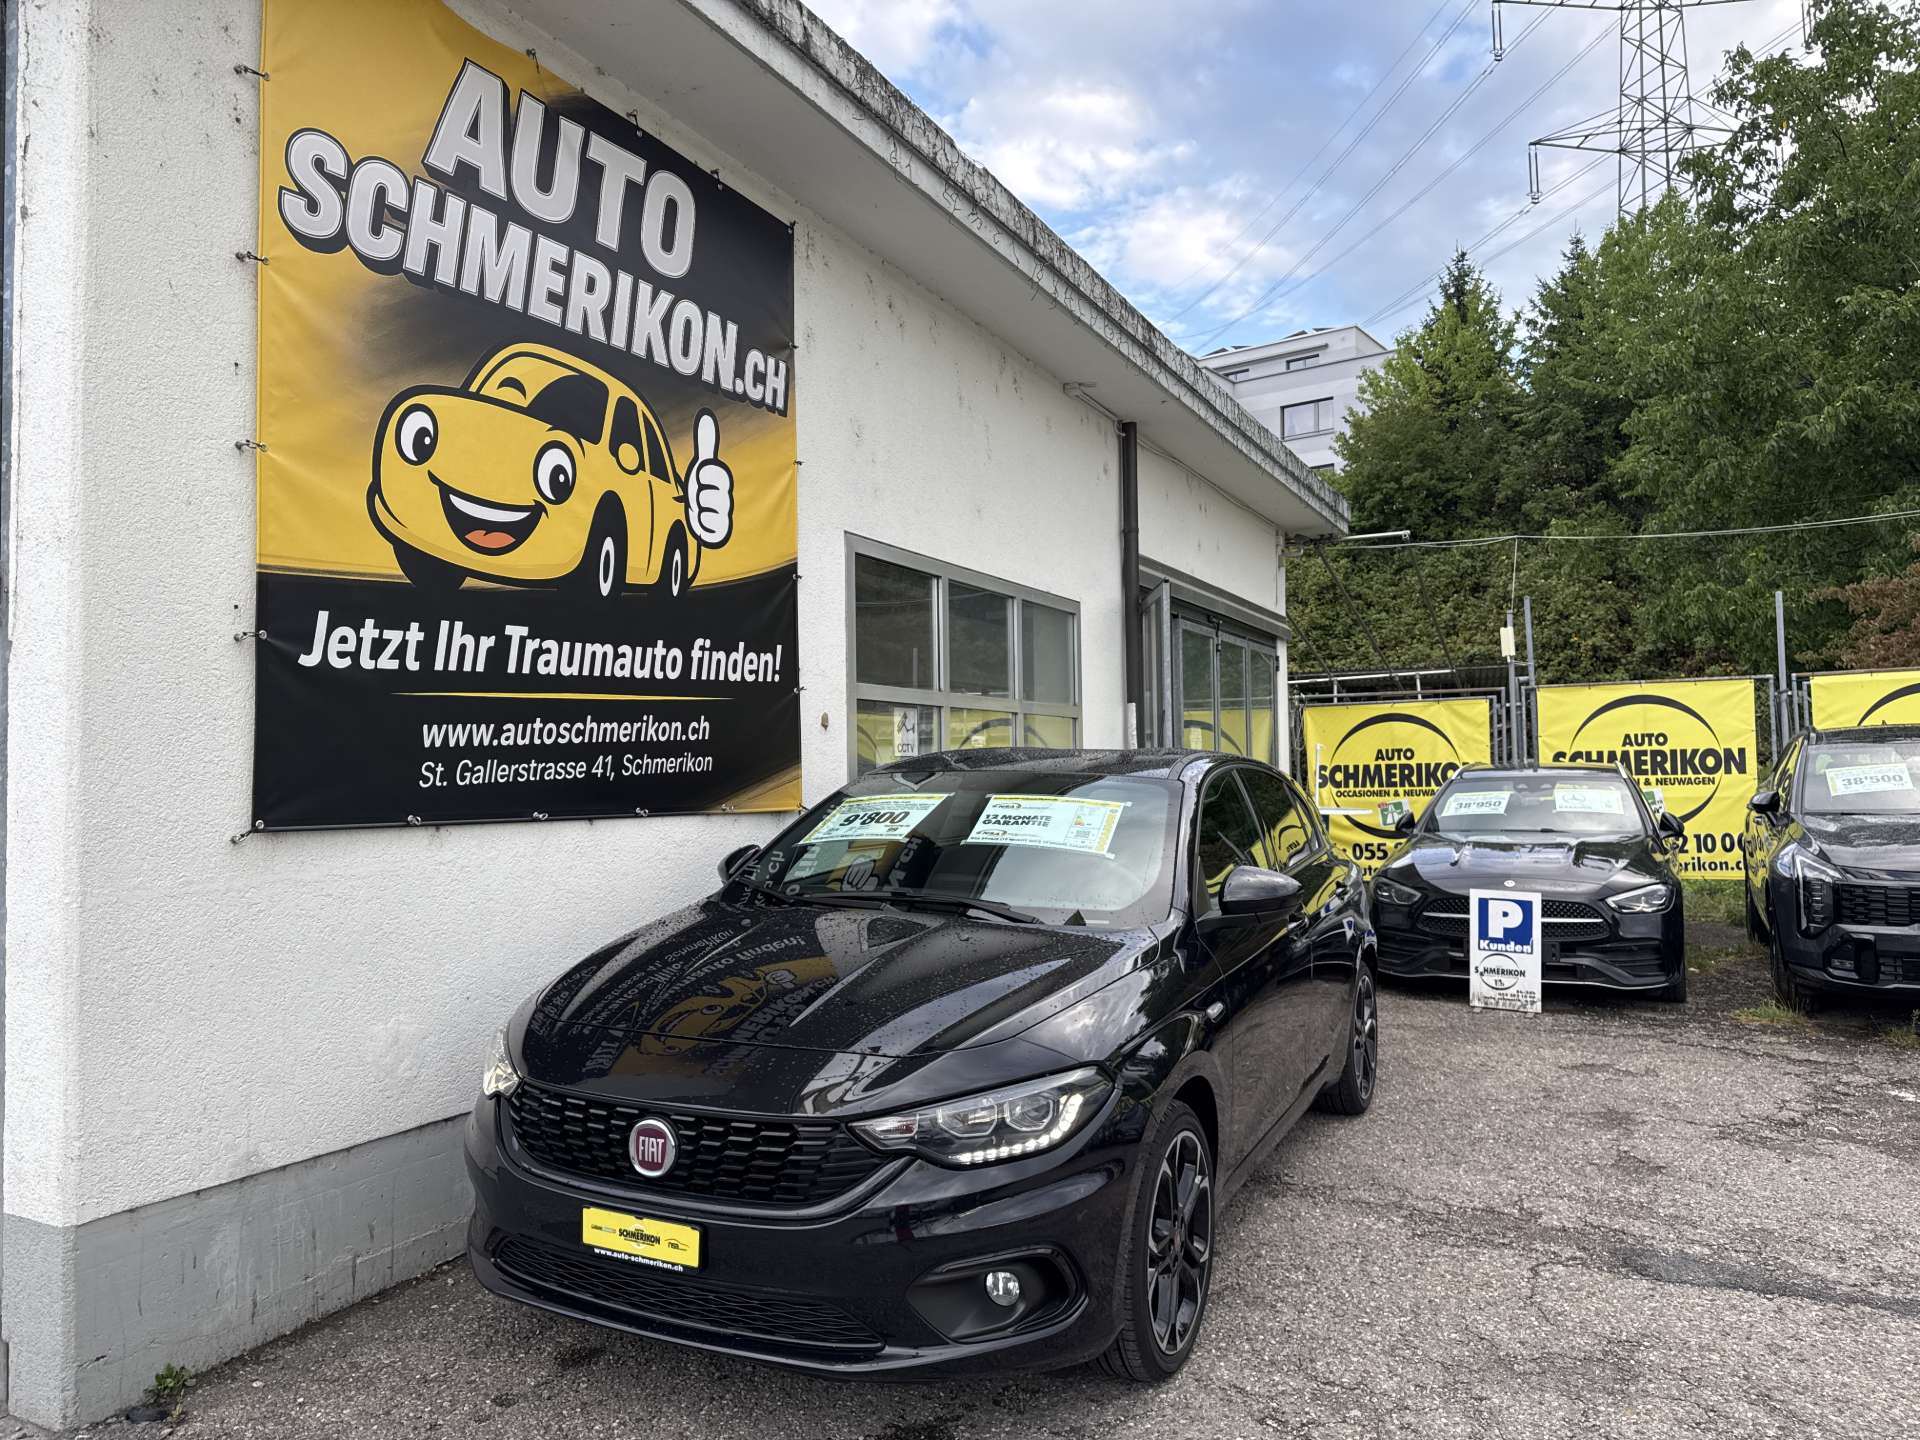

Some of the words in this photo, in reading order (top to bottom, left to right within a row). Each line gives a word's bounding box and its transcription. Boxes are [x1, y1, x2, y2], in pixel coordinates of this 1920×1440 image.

[421, 58, 697, 279] AUTO
[280, 128, 788, 414] SCHMERIKON.CH
[297, 610, 424, 673] Jetzt
[434, 619, 495, 673] Ihr
[504, 625, 683, 680] Traumauto
[691, 641, 783, 683] finden!
[421, 714, 710, 748] www.autoschmerikon.ch
[1622, 732, 1668, 747] AUTO
[1374, 748, 1415, 761] AUTO
[419, 761, 448, 788] St.
[456, 756, 587, 785] Gallerstrasse
[591, 754, 616, 783] 41,
[621, 753, 713, 777] Schmerikon
[1318, 762, 1474, 788] SCHMERIKO
[1643, 777, 1652, 786] &
[1655, 776, 1716, 786] NEUWAGEN
[1335, 788, 1391, 798] OCCASIONEN
[1393, 788, 1400, 797] &
[838, 810, 911, 827] 9'800
[982, 819, 1051, 828] GARANTIE
[999, 814, 1053, 822] MONATE
[1351, 842, 1389, 861] 055
[1693, 833, 1716, 853] 10
[1488, 899, 1524, 938] P
[1479, 940, 1532, 954] Kunden
[639, 1135, 665, 1163] FIAT
[618, 1228, 661, 1245] SCHMERIKON
